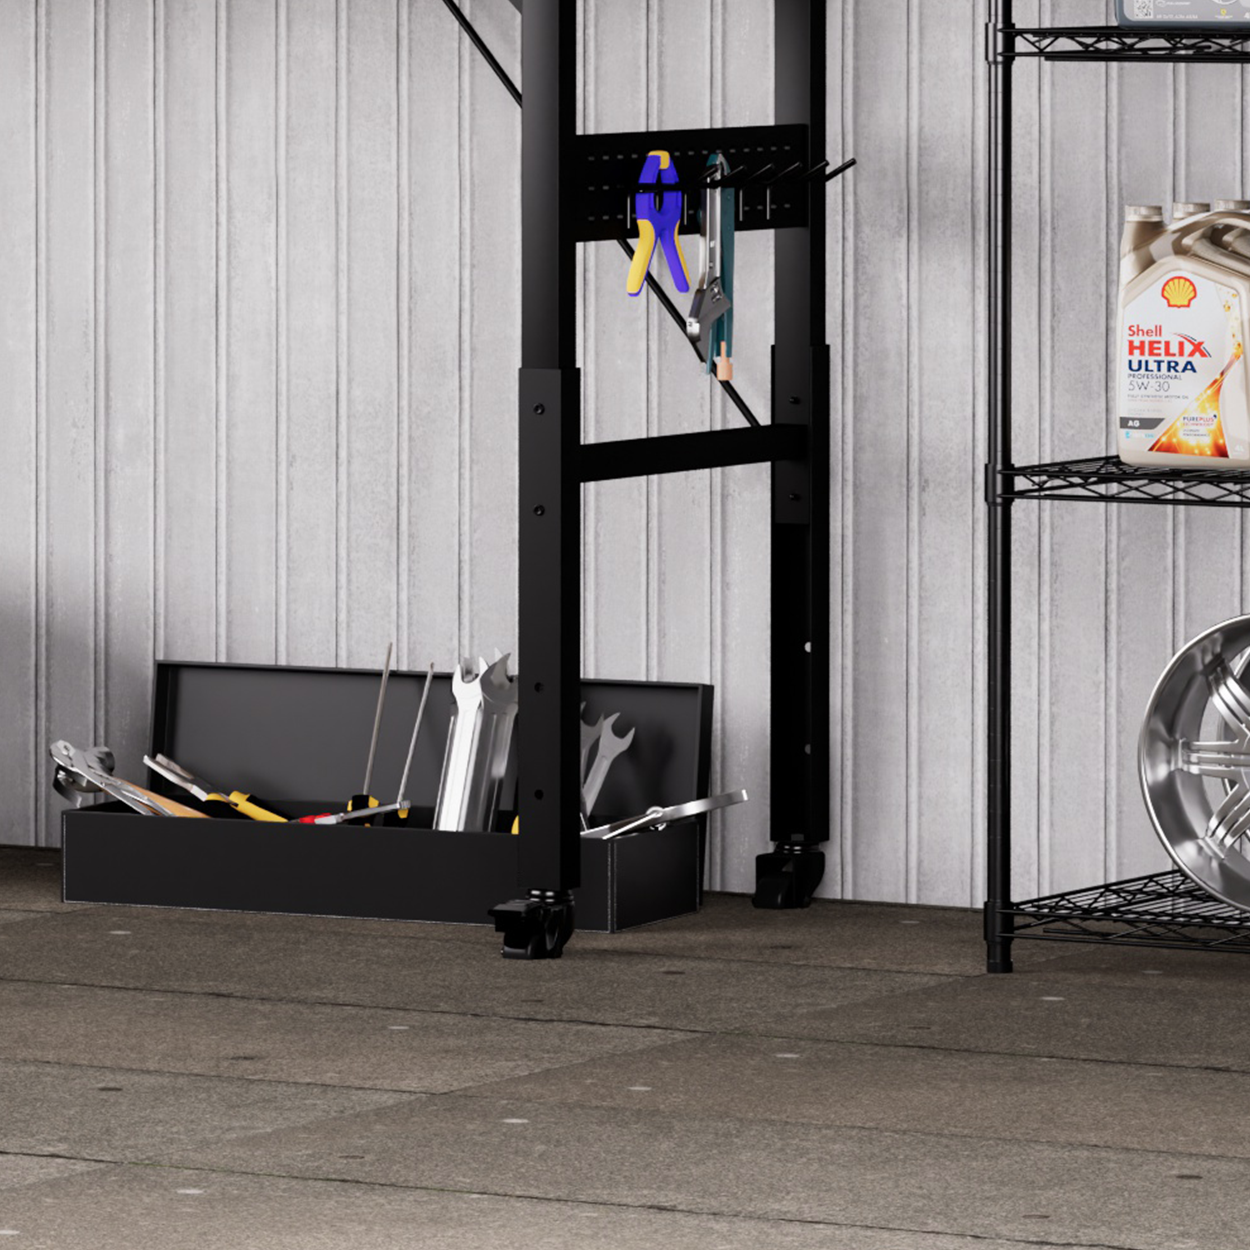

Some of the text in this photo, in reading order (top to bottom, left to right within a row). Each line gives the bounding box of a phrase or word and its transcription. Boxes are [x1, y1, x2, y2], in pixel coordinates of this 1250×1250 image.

[1128, 325, 1162, 337] Shell
[1128, 340, 1208, 357] HELIX
[1128, 359, 1197, 373] ULTRA
[1128, 381, 1170, 392] 5W-30
